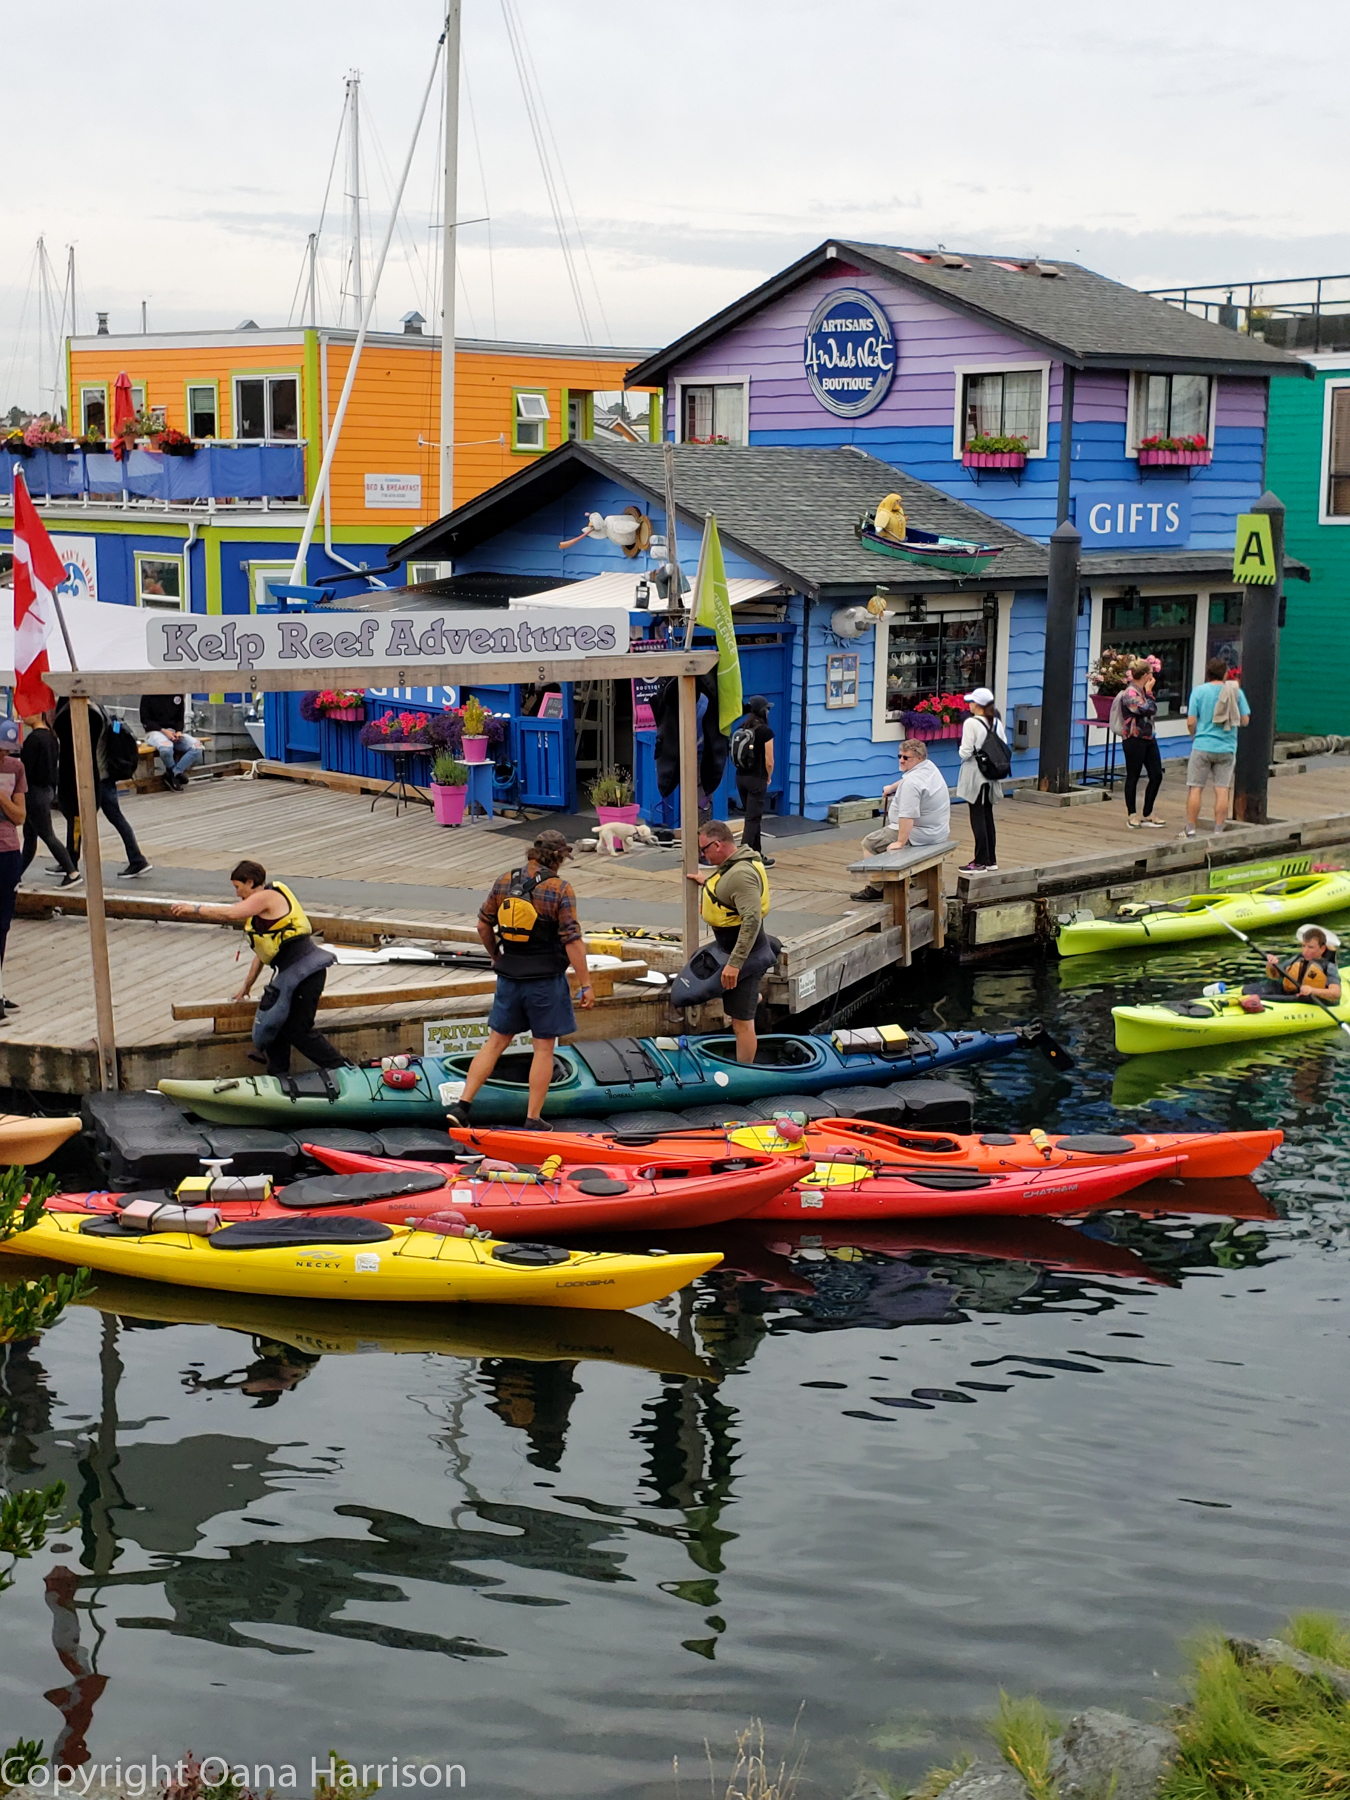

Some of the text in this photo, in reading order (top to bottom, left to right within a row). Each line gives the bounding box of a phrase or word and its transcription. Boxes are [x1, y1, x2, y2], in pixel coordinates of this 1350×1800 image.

[821, 318, 874, 332] ARTISANS
[805, 335, 820, 373] 4
[857, 335, 893, 371] Nest
[822, 377, 873, 391] BOUTIQUE
[386, 484, 420, 492] BREAKFAST
[1089, 502, 1180, 534] GIFTS
[1239, 531, 1267, 566] A
[714, 610, 738, 656] ELLENCE
[162, 618, 617, 670] Kelp Reef Adventures
[428, 1023, 490, 1041] PRIVAT
[443, 1043, 464, 1053] Not
[1023, 1183, 1079, 1199] CHATHAM
